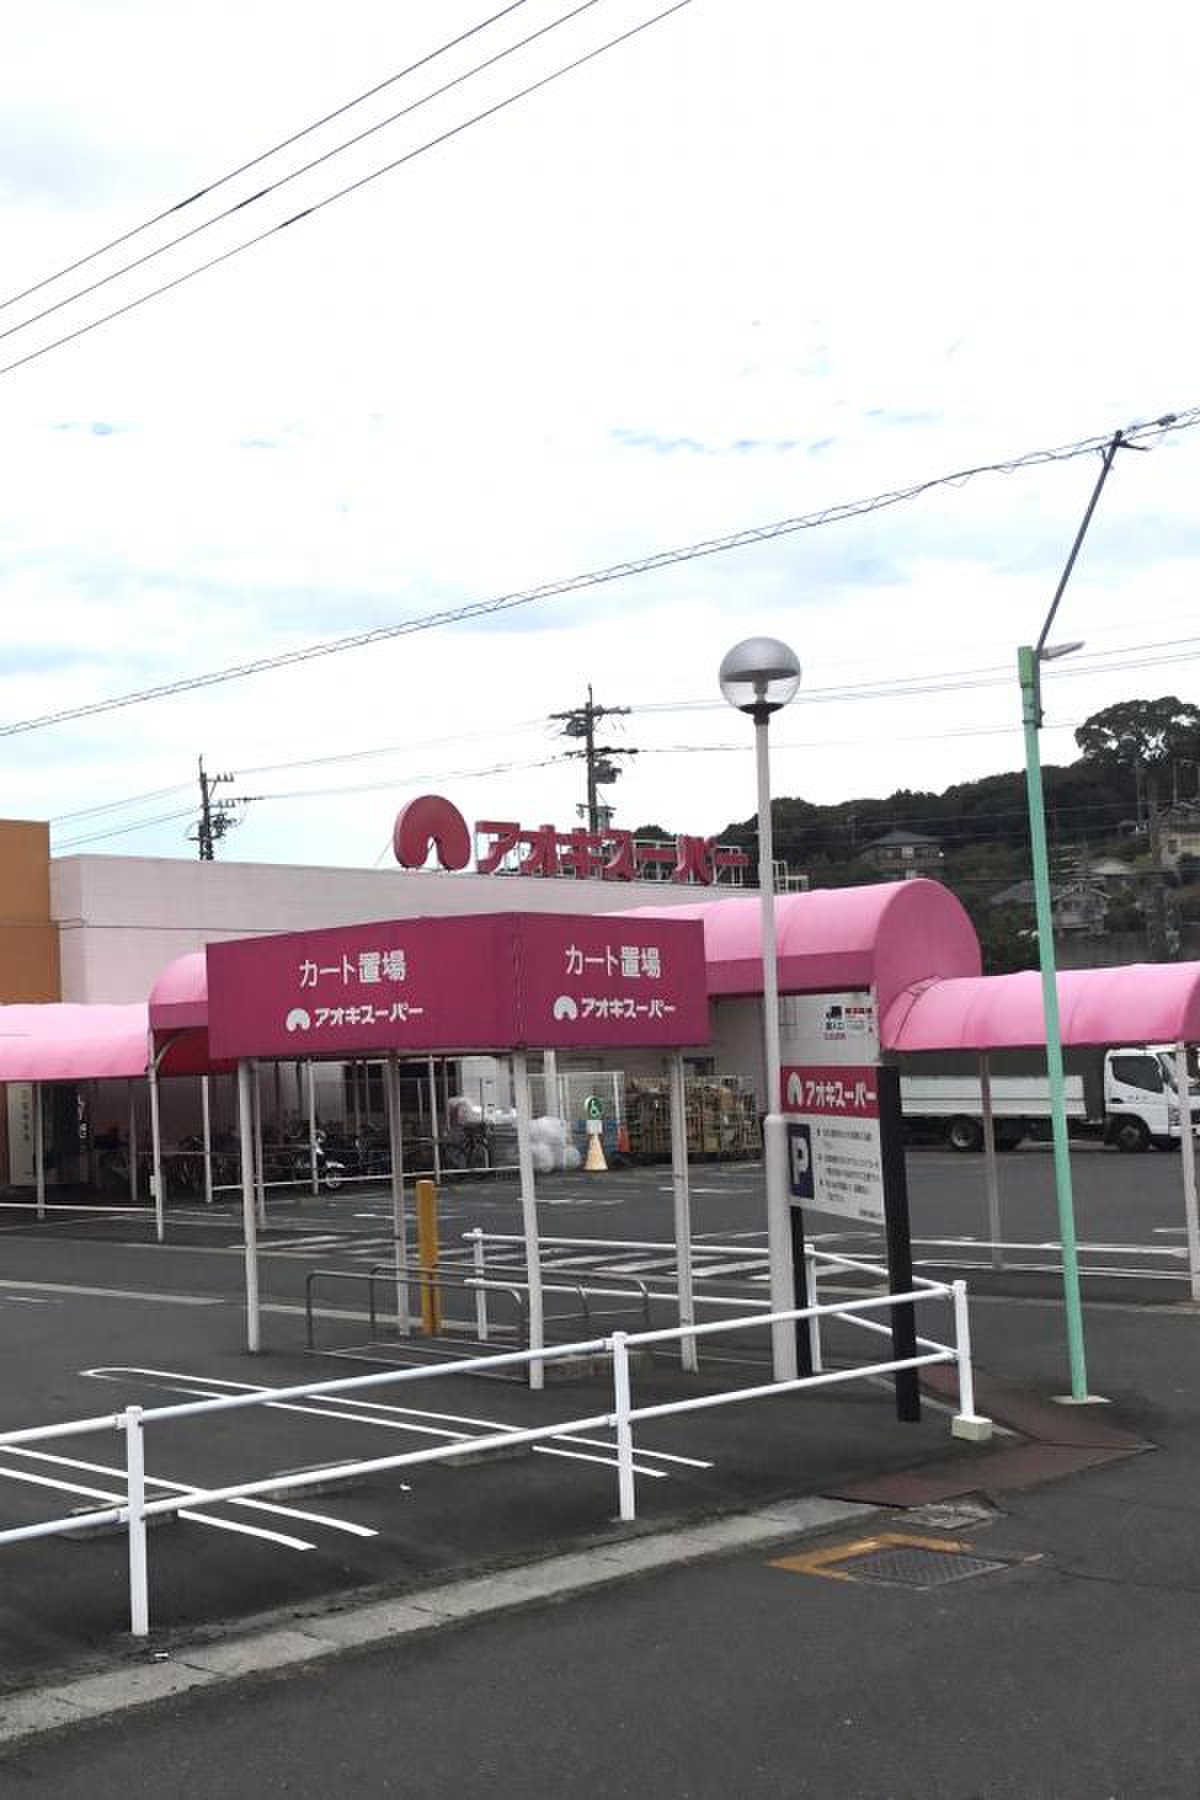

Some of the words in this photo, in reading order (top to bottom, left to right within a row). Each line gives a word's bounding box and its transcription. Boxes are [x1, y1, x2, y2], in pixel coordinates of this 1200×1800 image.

[475, 821, 752, 886] アオキスーパー
[299, 949, 406, 988] カート置場
[565, 944, 661, 978] カート置場
[315, 1002, 423, 1027] アオキスーパー
[581, 997, 676, 1019] アオキスーパー
[805, 1080, 877, 1109] アオキスーパー
